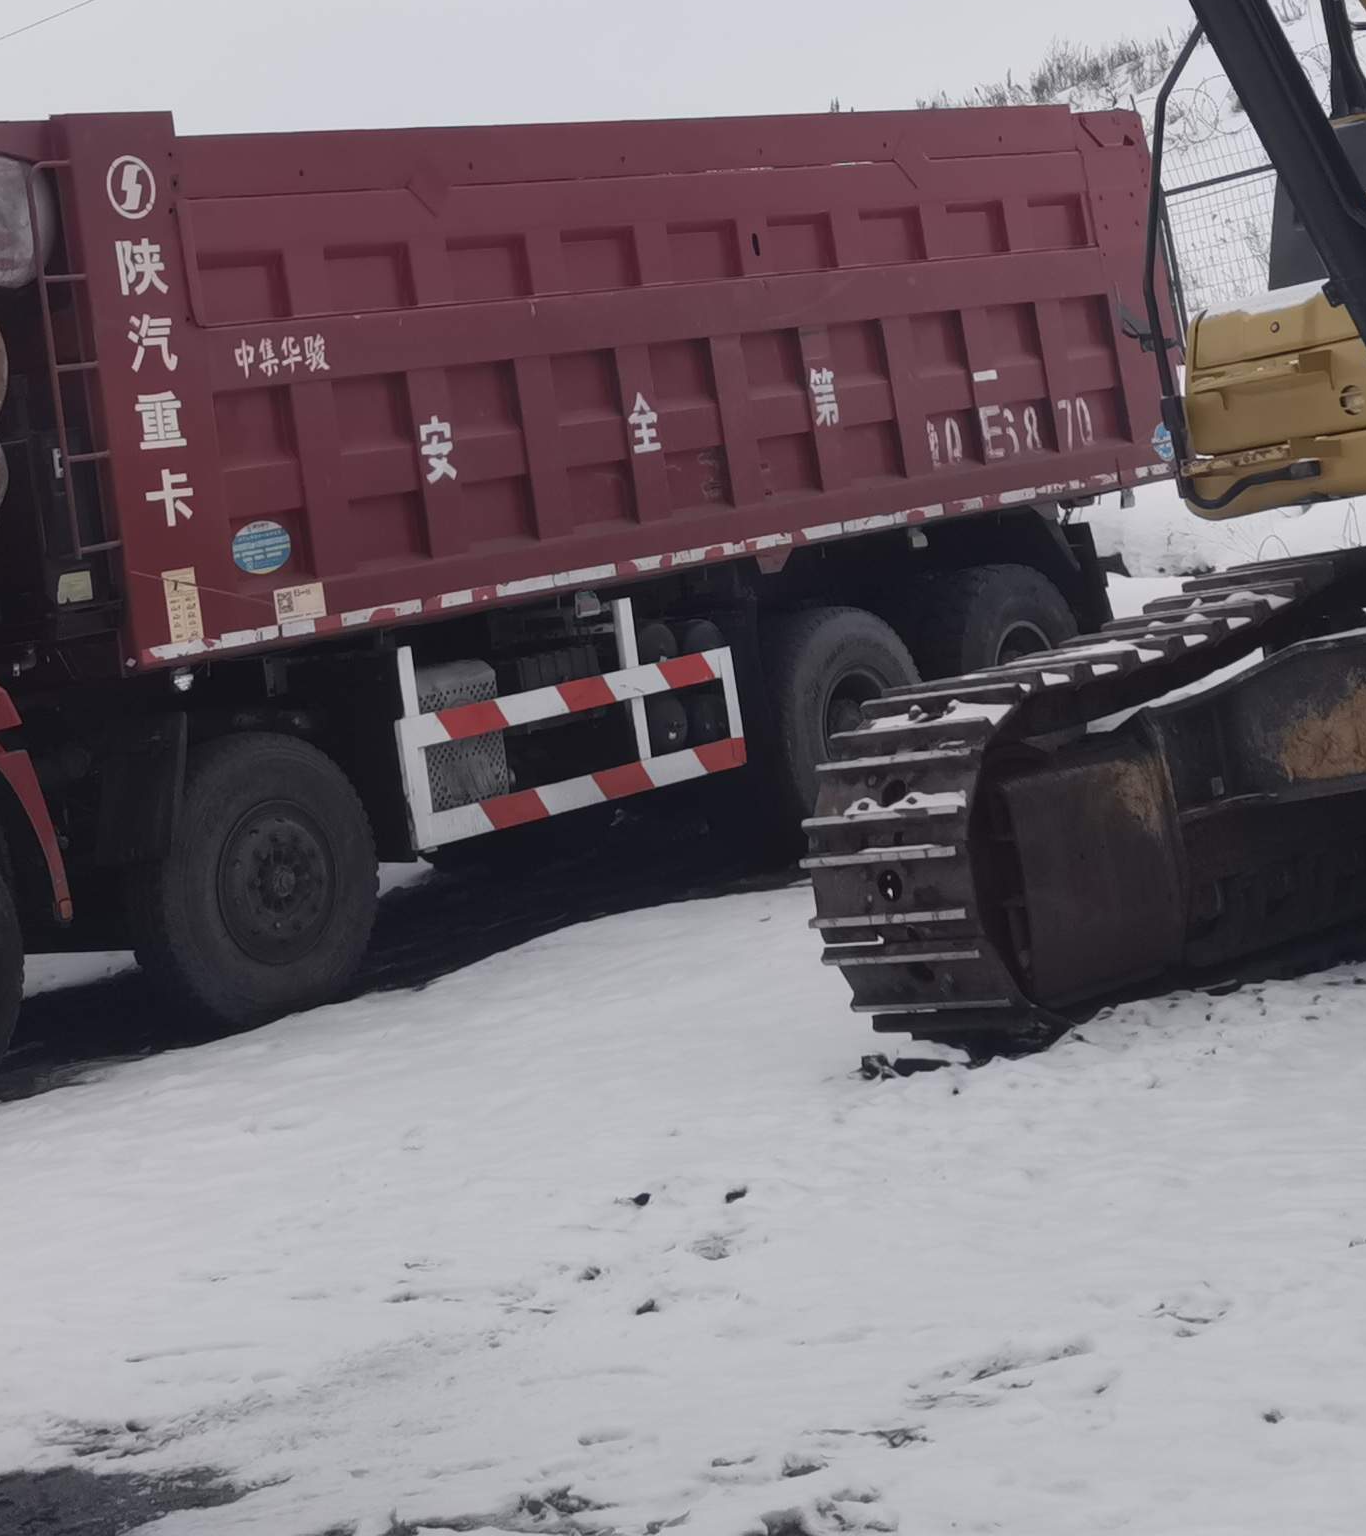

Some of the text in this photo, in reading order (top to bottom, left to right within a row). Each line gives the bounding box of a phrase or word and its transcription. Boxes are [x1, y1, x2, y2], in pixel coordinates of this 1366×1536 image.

[115, 238, 194, 527] 陕汽重卡
[234, 333, 330, 379] 中集华骏
